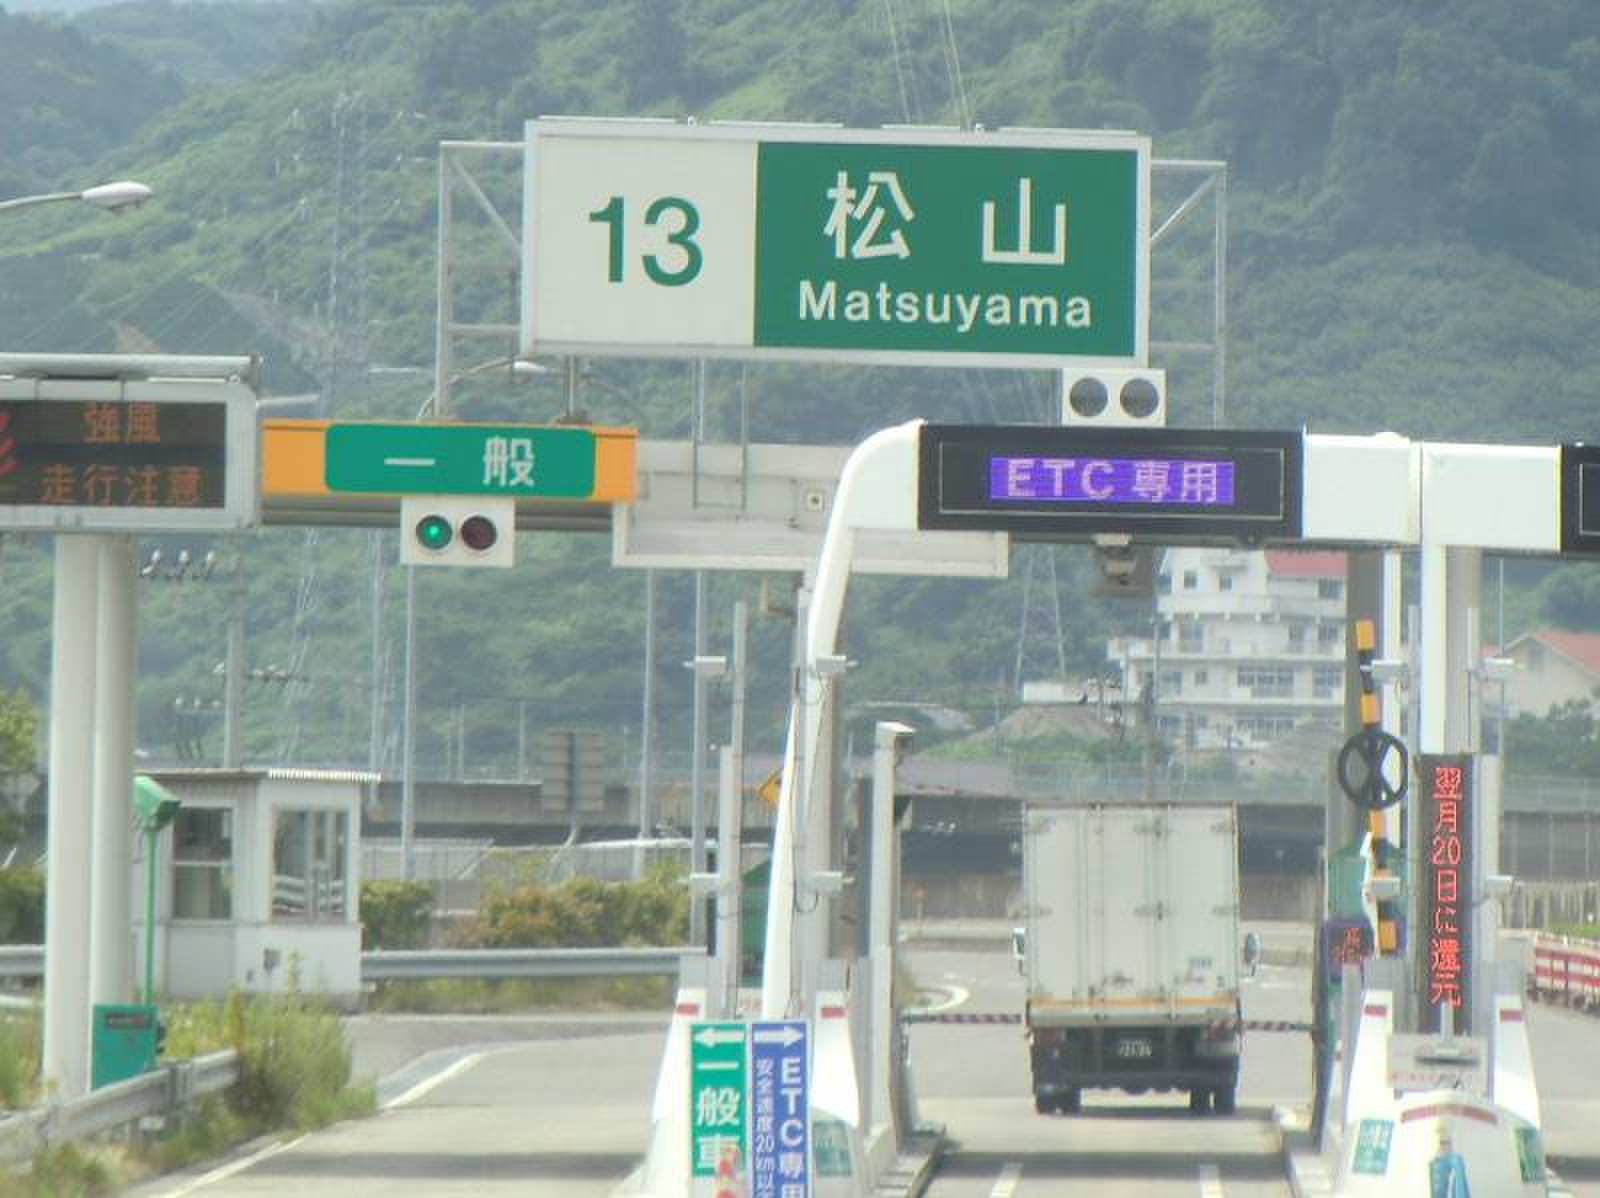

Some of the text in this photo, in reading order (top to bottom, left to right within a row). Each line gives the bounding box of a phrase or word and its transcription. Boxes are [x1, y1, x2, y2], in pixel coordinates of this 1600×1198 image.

[588, 196, 704, 286] 13
[824, 170, 1066, 266] 松山
[798, 281, 1093, 333] Matsuyama
[82, 402, 160, 444] 強風
[40, 464, 203, 506] 走行注意
[383, 435, 535, 487] 一般
